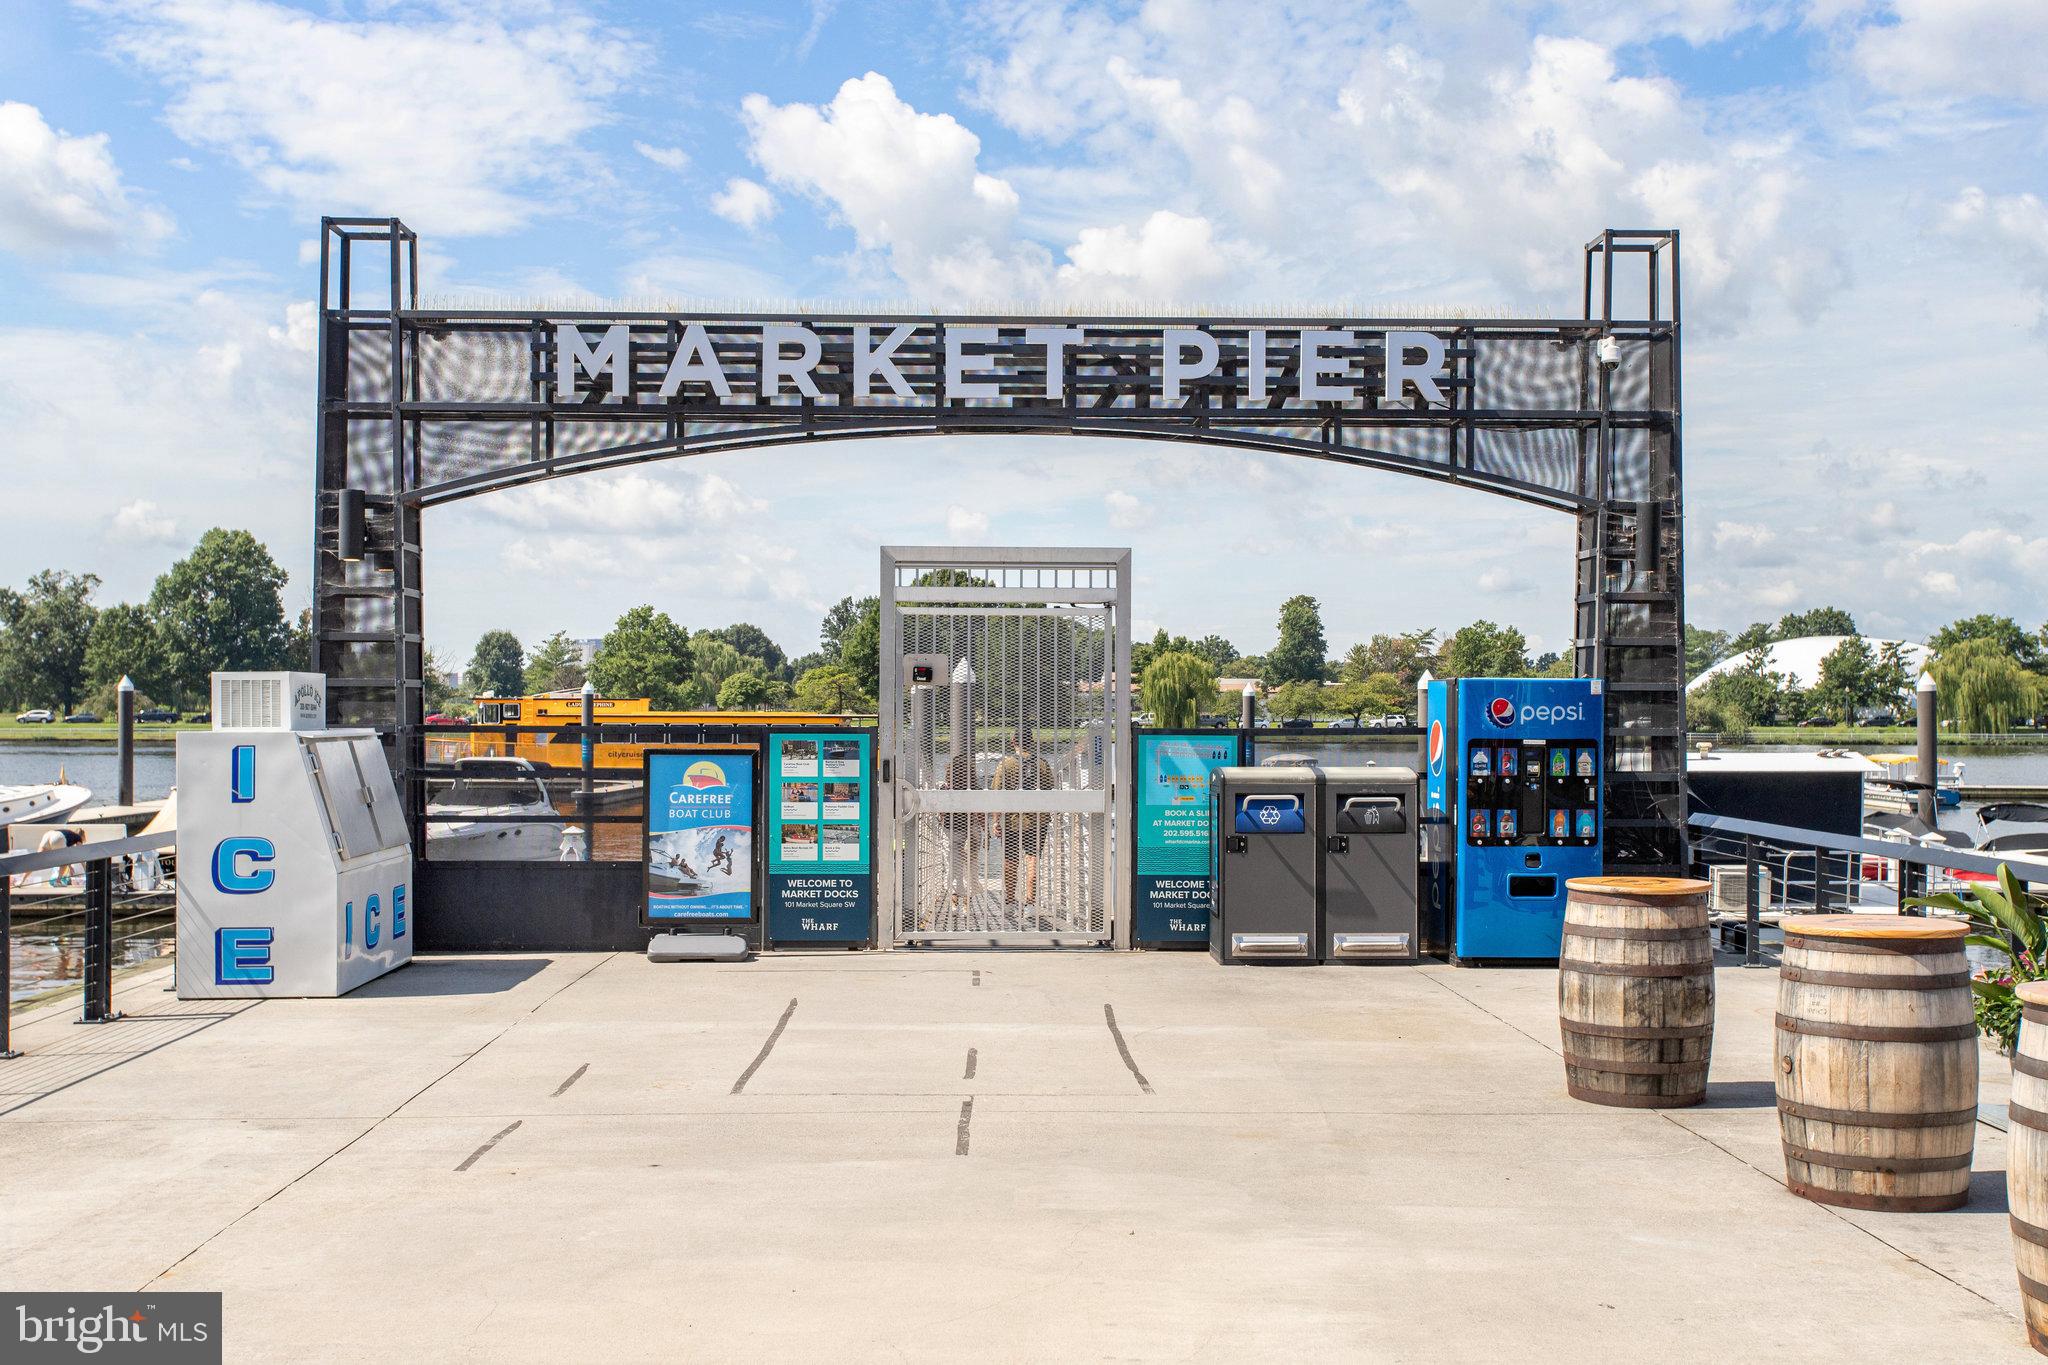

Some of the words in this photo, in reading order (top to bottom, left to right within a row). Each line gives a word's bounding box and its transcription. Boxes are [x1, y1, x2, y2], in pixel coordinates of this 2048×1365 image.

[553, 322, 1084, 400] MARKET
[1163, 328, 1447, 402] PIER
[1520, 702, 1582, 725] pepsi
[669, 792, 731, 804] CAREFREE
[669, 809, 698, 818] BOAT
[701, 809, 731, 818] CLUB
[211, 744, 276, 986] ICE
[787, 880, 837, 888] WELCOME
[839, 880, 853, 888] TO
[1155, 880, 1205, 889] WELCOME
[781, 890, 822, 898] MARKET
[824, 890, 859, 898] DOCKS
[1149, 891, 1190, 899] MARKET
[820, 901, 843, 909] Square
[1187, 902, 1210, 910] Square
[345, 883, 407, 961] ICE
